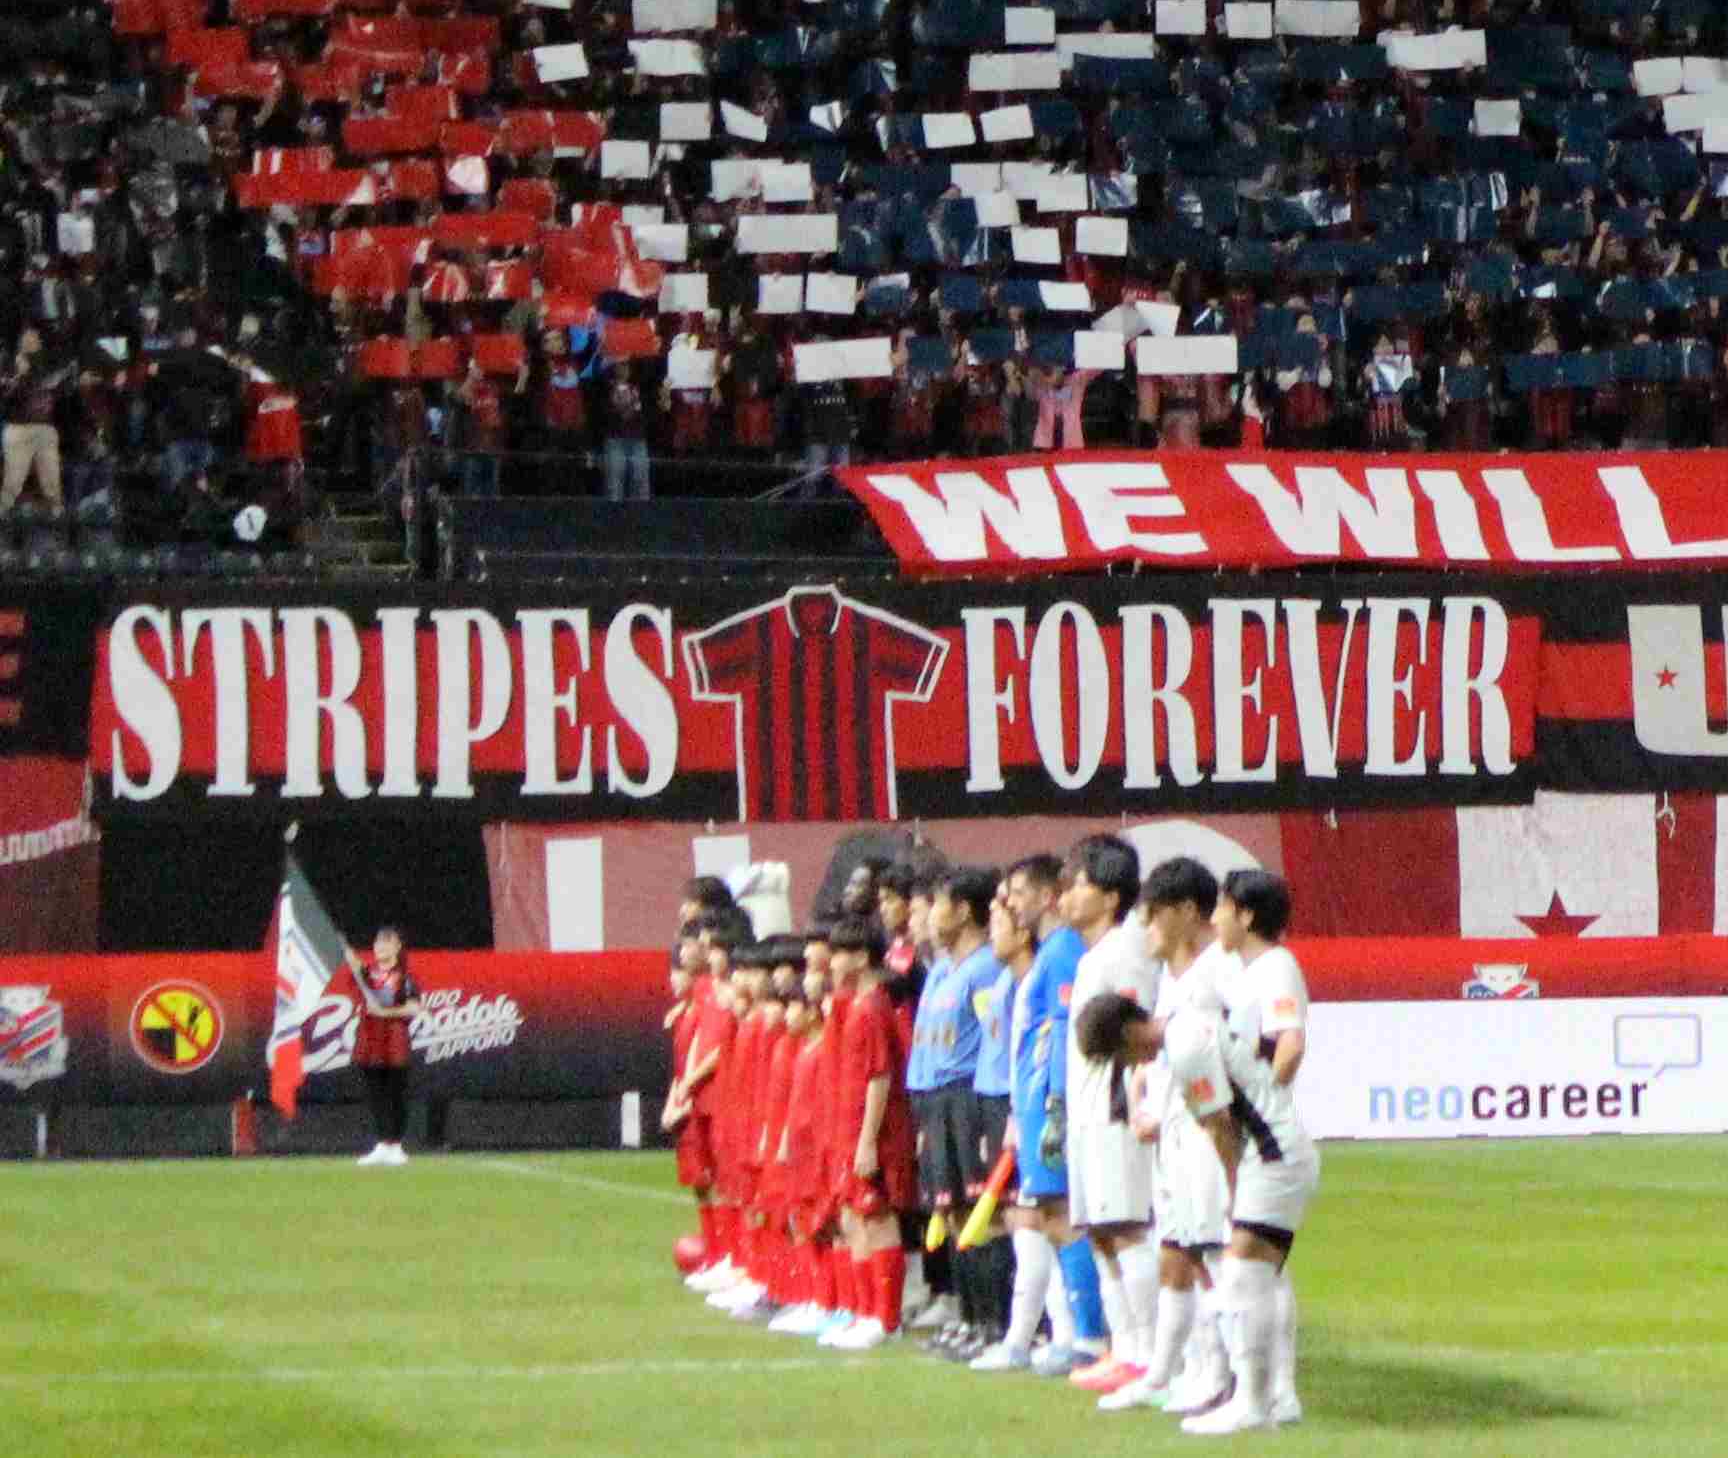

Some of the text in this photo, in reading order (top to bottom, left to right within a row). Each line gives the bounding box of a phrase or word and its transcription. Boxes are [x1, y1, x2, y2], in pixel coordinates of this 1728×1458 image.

[868, 462, 1208, 561] WE
[109, 602, 680, 802] STRIPES
[960, 595, 1516, 793] FOREVER
[1369, 1079, 1647, 1122] neocareer
